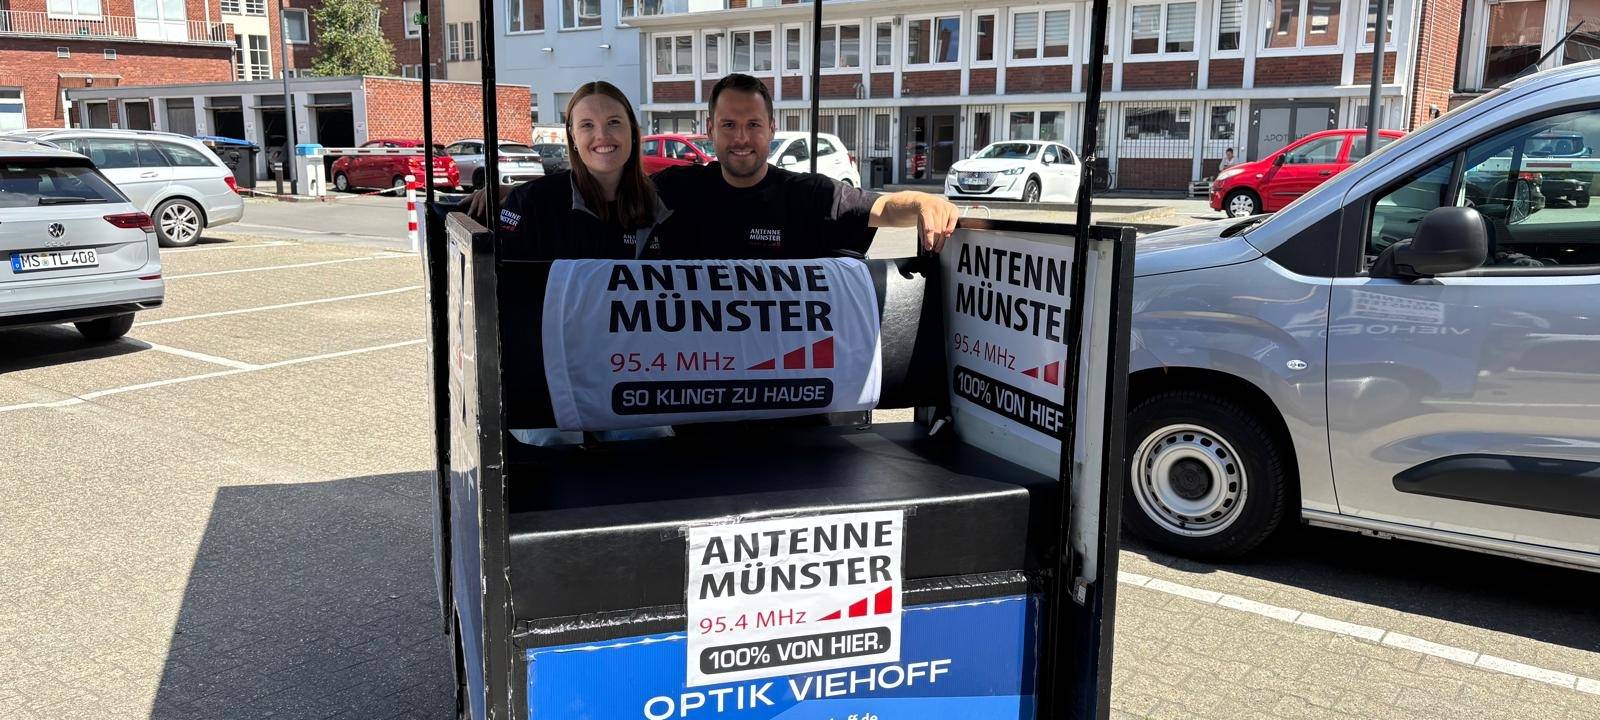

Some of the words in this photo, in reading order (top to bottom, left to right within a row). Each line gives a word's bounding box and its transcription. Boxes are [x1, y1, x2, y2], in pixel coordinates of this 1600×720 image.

[20, 254, 41, 268] MS
[49, 252, 68, 266] TL
[71, 251, 96, 264] 408
[607, 264, 830, 292] ANTENNE
[609, 292, 834, 333] MÜNSTER
[610, 352, 667, 373] 95.4
[676, 351, 735, 371] MHz
[954, 333, 981, 357] 95.4
[984, 341, 1016, 371] MHz
[622, 389, 649, 407] SO
[656, 387, 727, 406] KLINGT
[731, 387, 757, 404] ZU
[763, 385, 826, 403] HAUSE
[957, 370, 992, 404] 100%
[995, 385, 1025, 418] VON
[701, 520, 893, 566] ANTENNE
[699, 555, 893, 600] MÜNSTER
[699, 614, 749, 635] 95.4
[756, 608, 807, 629] MHz
[708, 646, 771, 670] 100%
[777, 638, 823, 662] VON
[831, 632, 884, 651] HIER.
[643, 682, 775, 720] OPTIK
[788, 659, 952, 701] VIEHOFF
